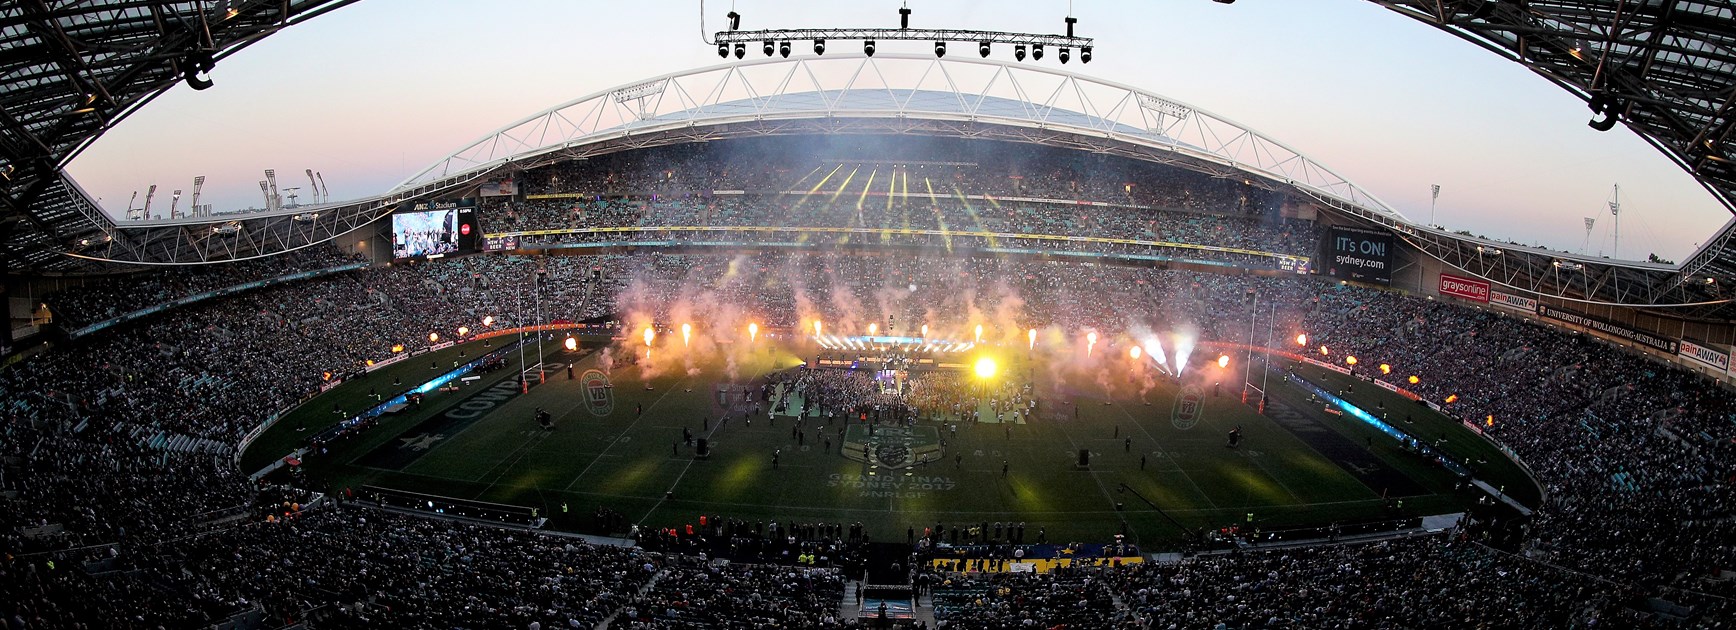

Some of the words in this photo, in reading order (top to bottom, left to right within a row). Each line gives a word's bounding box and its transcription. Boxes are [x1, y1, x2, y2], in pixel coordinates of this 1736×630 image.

[1337, 237, 1355, 252] IT's
[1360, 241, 1385, 256] ON!
[1336, 255, 1384, 269] sydney.com
[1443, 280, 1485, 295] graysonline
[1492, 292, 1528, 307] painAWAY
[1547, 309, 1583, 324] UNIVERSITY
[1681, 343, 1719, 364] painAWAY
[590, 388, 605, 400] VB
[826, 480, 901, 489] SYDNEY
[909, 483, 956, 491] 2017
[829, 474, 894, 482] GRAND
[901, 476, 955, 484] FINAL
